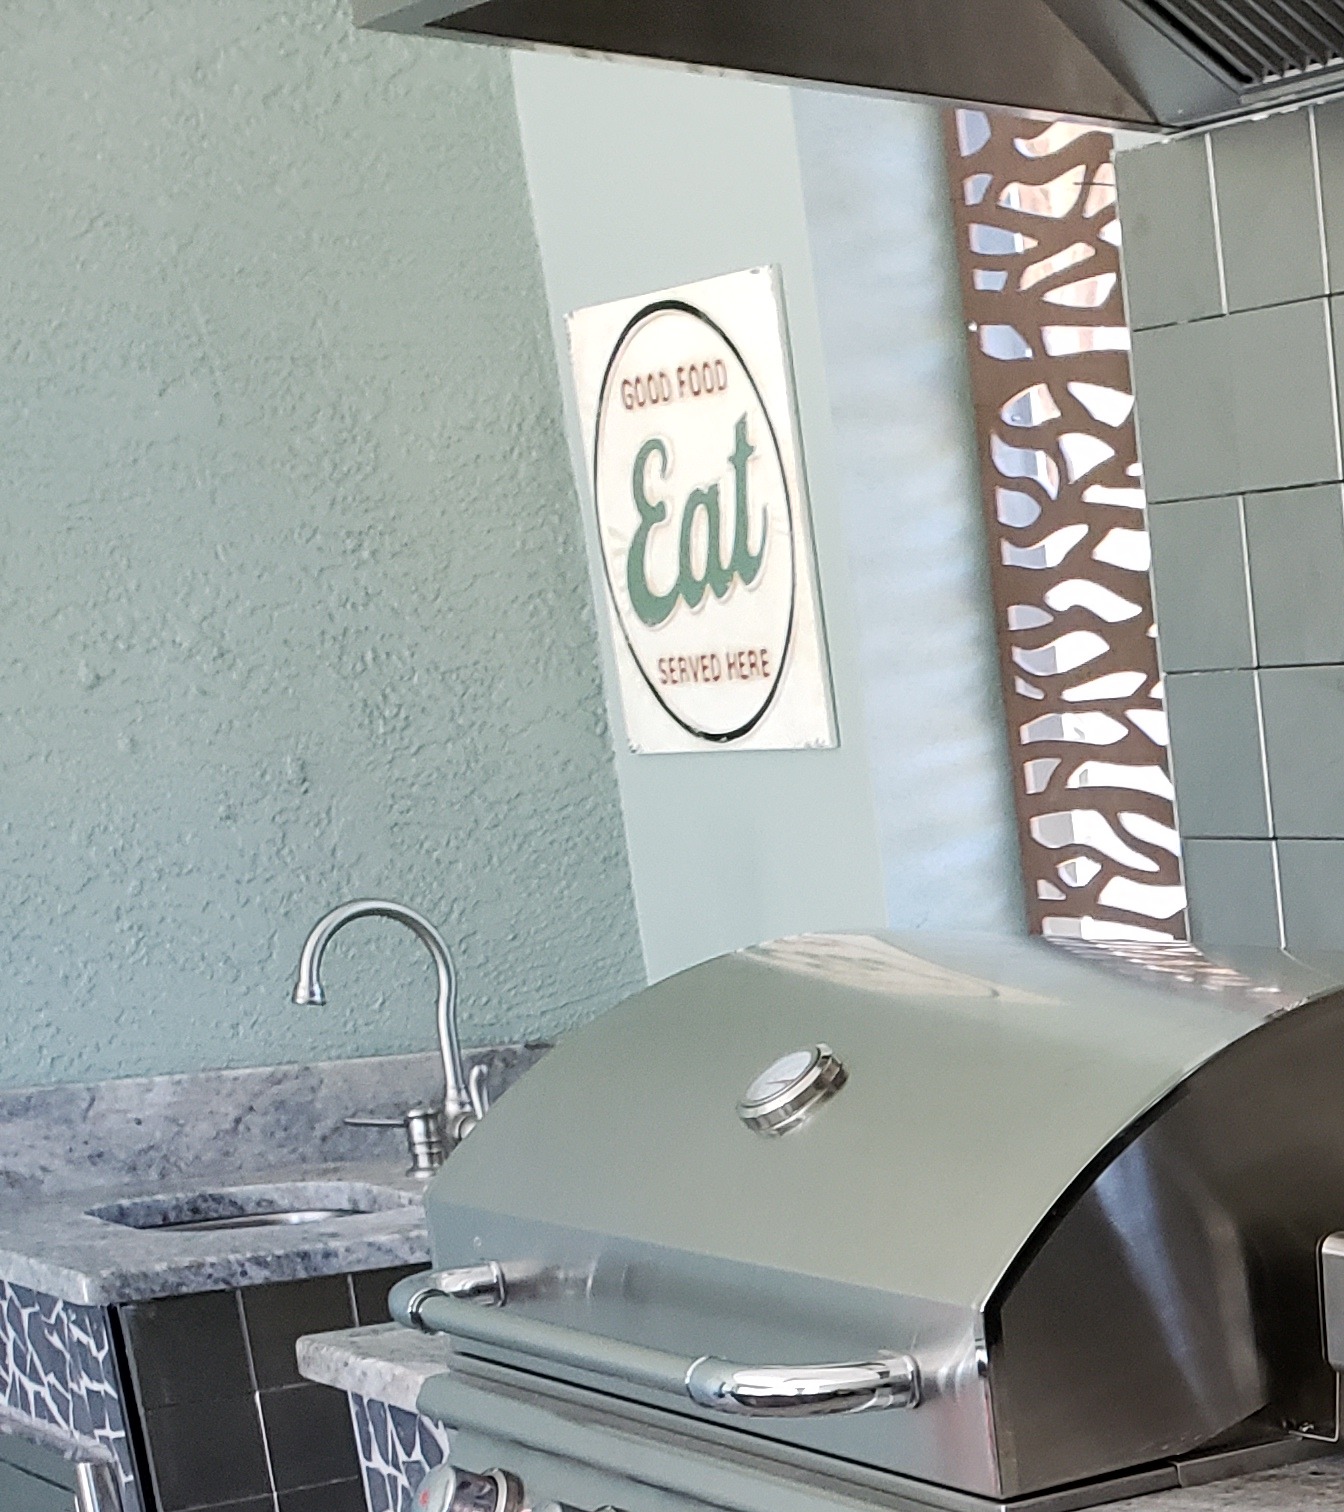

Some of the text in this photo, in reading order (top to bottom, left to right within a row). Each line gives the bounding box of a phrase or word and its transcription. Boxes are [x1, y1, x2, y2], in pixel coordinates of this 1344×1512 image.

[620, 358, 728, 411] GOOD FOOD
[626, 411, 769, 628] Eat
[657, 648, 771, 686] SERVED HERE
